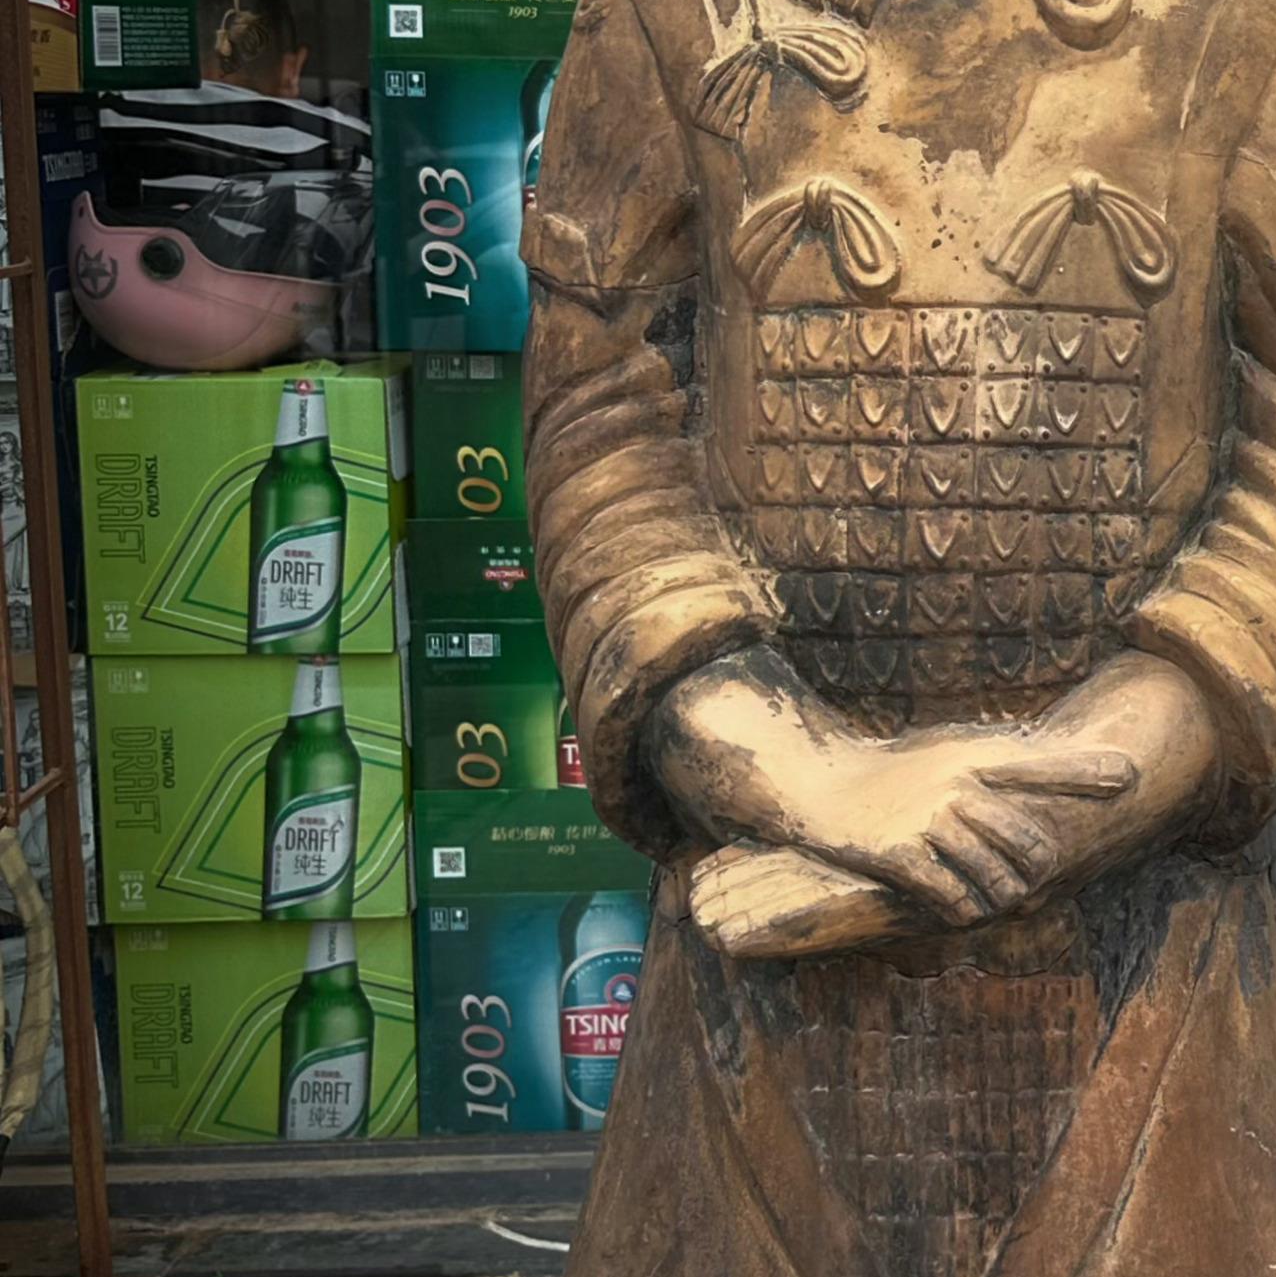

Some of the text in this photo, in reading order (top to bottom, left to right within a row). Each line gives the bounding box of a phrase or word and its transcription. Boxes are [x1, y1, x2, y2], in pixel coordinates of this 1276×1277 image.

[508, 6, 539, 19] 1903
[418, 166, 479, 307] 1903
[95, 453, 147, 564] DRAFT
[270, 559, 326, 587] DRAFT
[279, 586, 315, 612] 纯生
[105, 613, 129, 631] 12
[111, 726, 162, 834] DRAFT
[284, 827, 340, 853] DRAFT
[121, 883, 144, 900] 12
[130, 982, 179, 1090] DRAFT
[460, 993, 516, 1123] 1903
[300, 1079, 352, 1106] DRAFT
